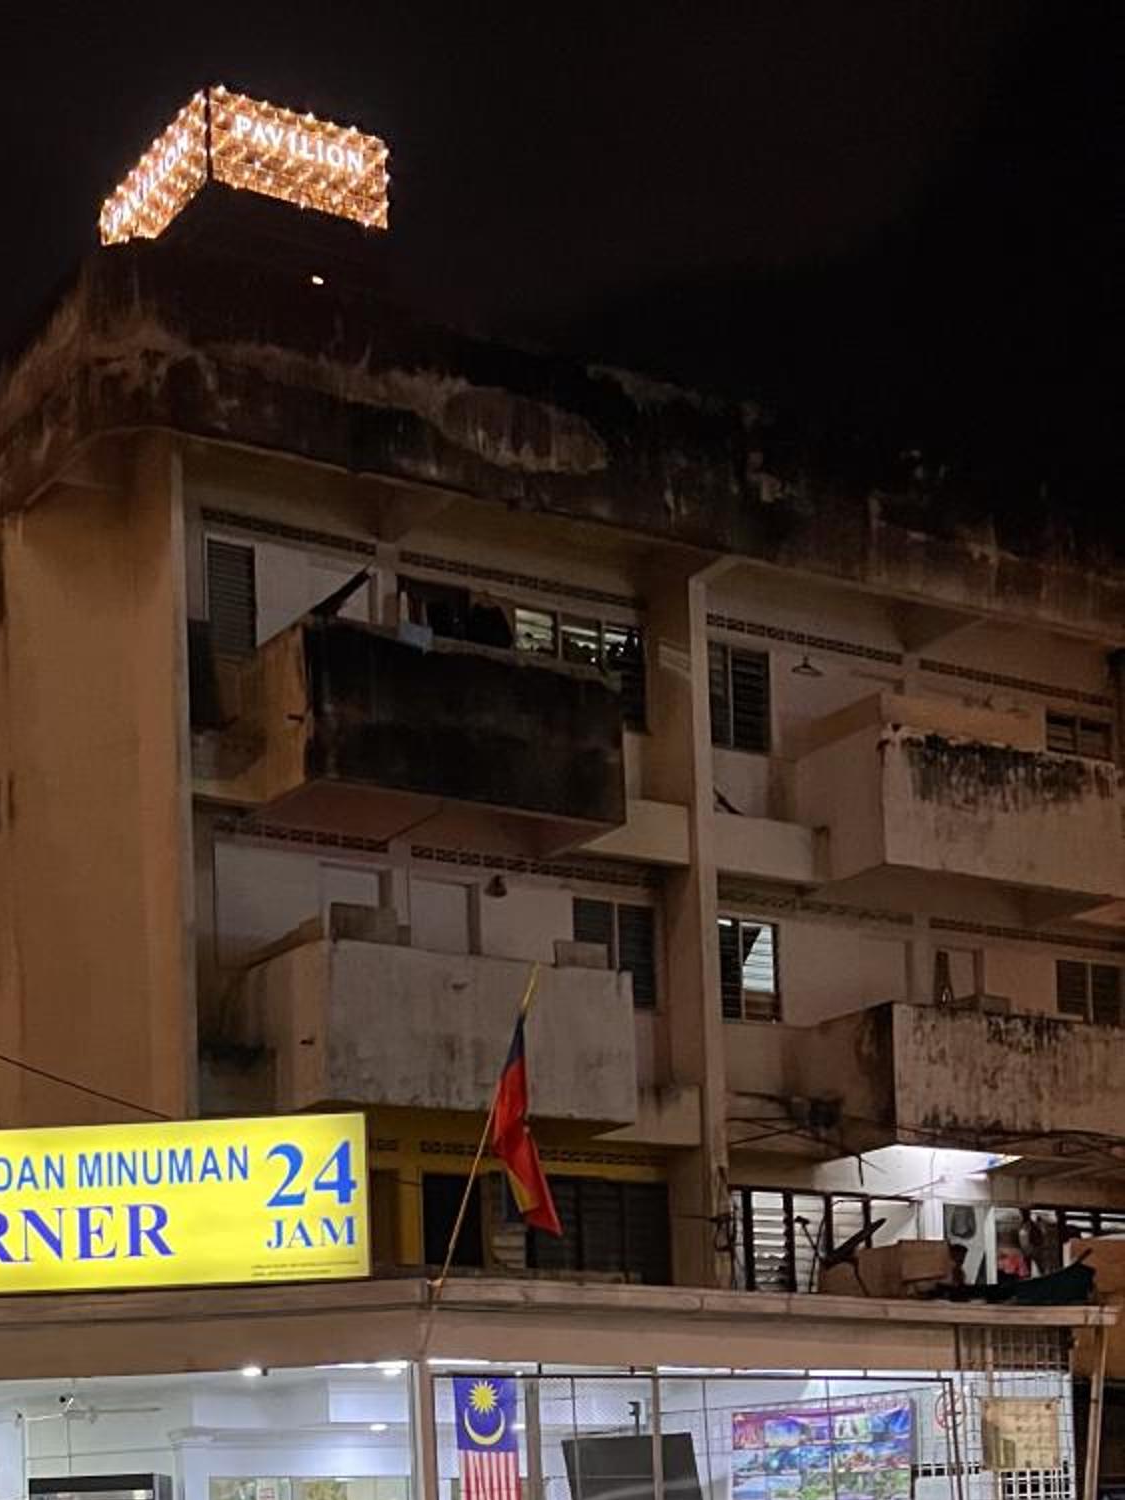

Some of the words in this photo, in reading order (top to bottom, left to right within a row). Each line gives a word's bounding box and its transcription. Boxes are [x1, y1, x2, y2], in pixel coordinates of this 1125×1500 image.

[233, 114, 364, 172] PAVILION
[77, 1145, 249, 1188] MINUMAN
[266, 1141, 357, 1209] 24
[266, 1216, 357, 1250] JAM
